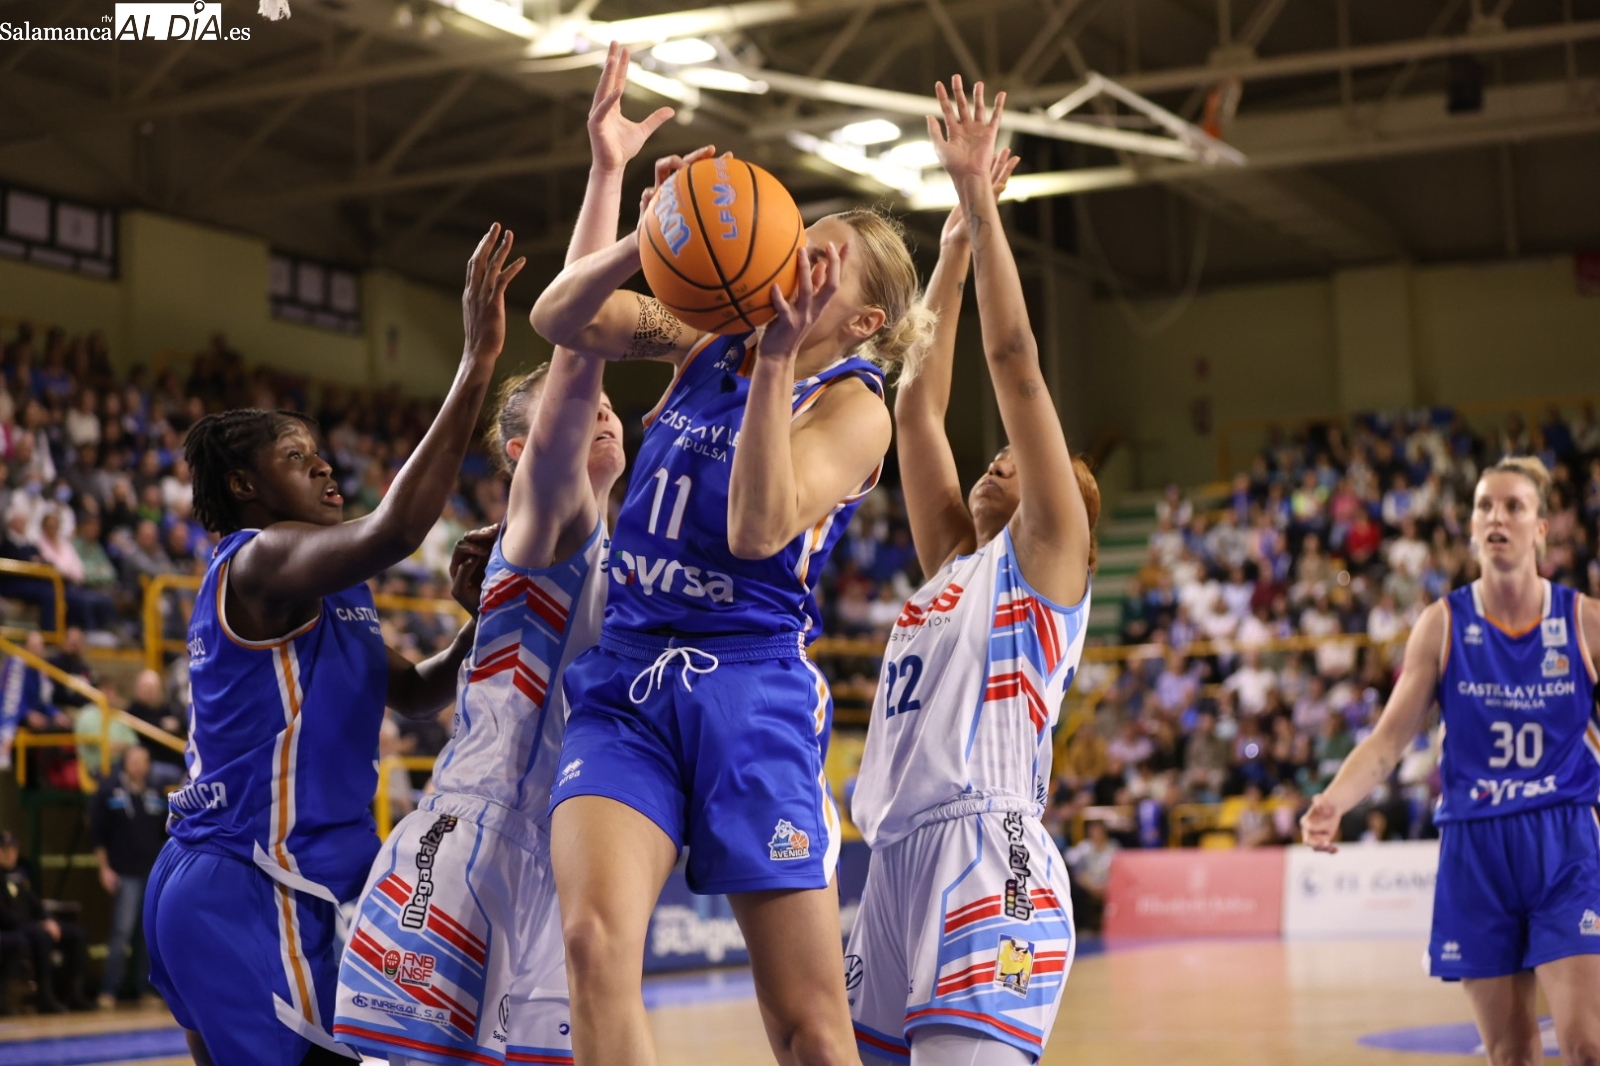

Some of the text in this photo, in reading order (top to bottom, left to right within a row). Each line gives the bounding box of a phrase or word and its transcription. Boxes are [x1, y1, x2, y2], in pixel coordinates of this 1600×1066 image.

[653, 466, 692, 540] 11
[885, 655, 923, 720] 22
[1458, 681, 1524, 699] CASTILLA
[1489, 721, 1543, 768] 30
[772, 848, 809, 859] AVENIDA
